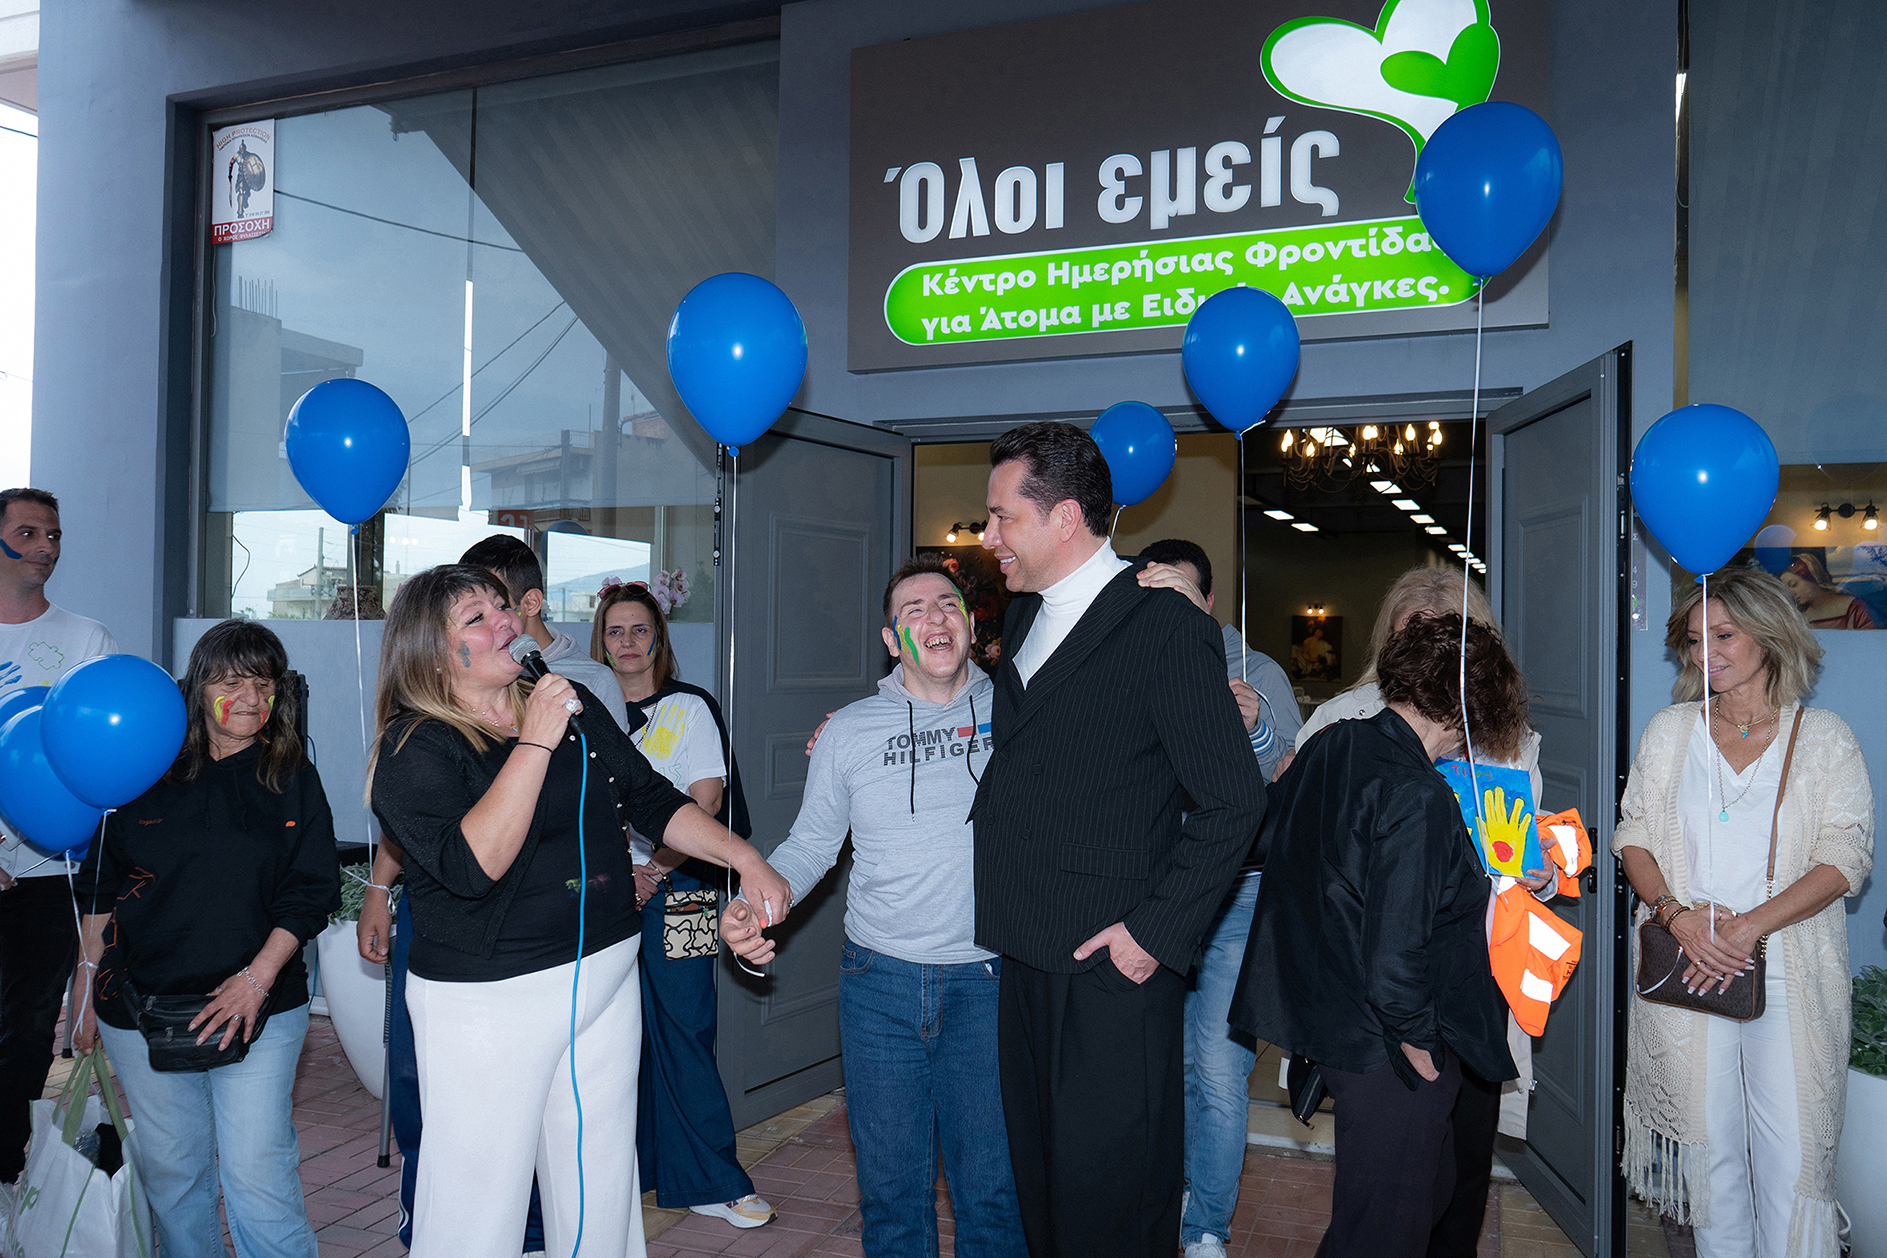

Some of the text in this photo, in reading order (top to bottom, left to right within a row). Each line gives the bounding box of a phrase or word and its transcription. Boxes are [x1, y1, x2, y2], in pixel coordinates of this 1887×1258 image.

[216, 128, 271, 149] HIGH PROTECTION
[884, 115, 1340, 244] Όλοι εμείς
[214, 218, 270, 236] ΠΡΟΣΟΧΗ
[923, 226, 1446, 296] Κέντρο Ημερήσιας Φροντίδα
[921, 314, 972, 341] για
[980, 305, 1082, 332] Άτομα
[1092, 301, 1131, 328] με
[1282, 274, 1450, 307] Ανάγκες.
[883, 736, 995, 766] HILFIGER
[886, 726, 956, 750] TOMMY
